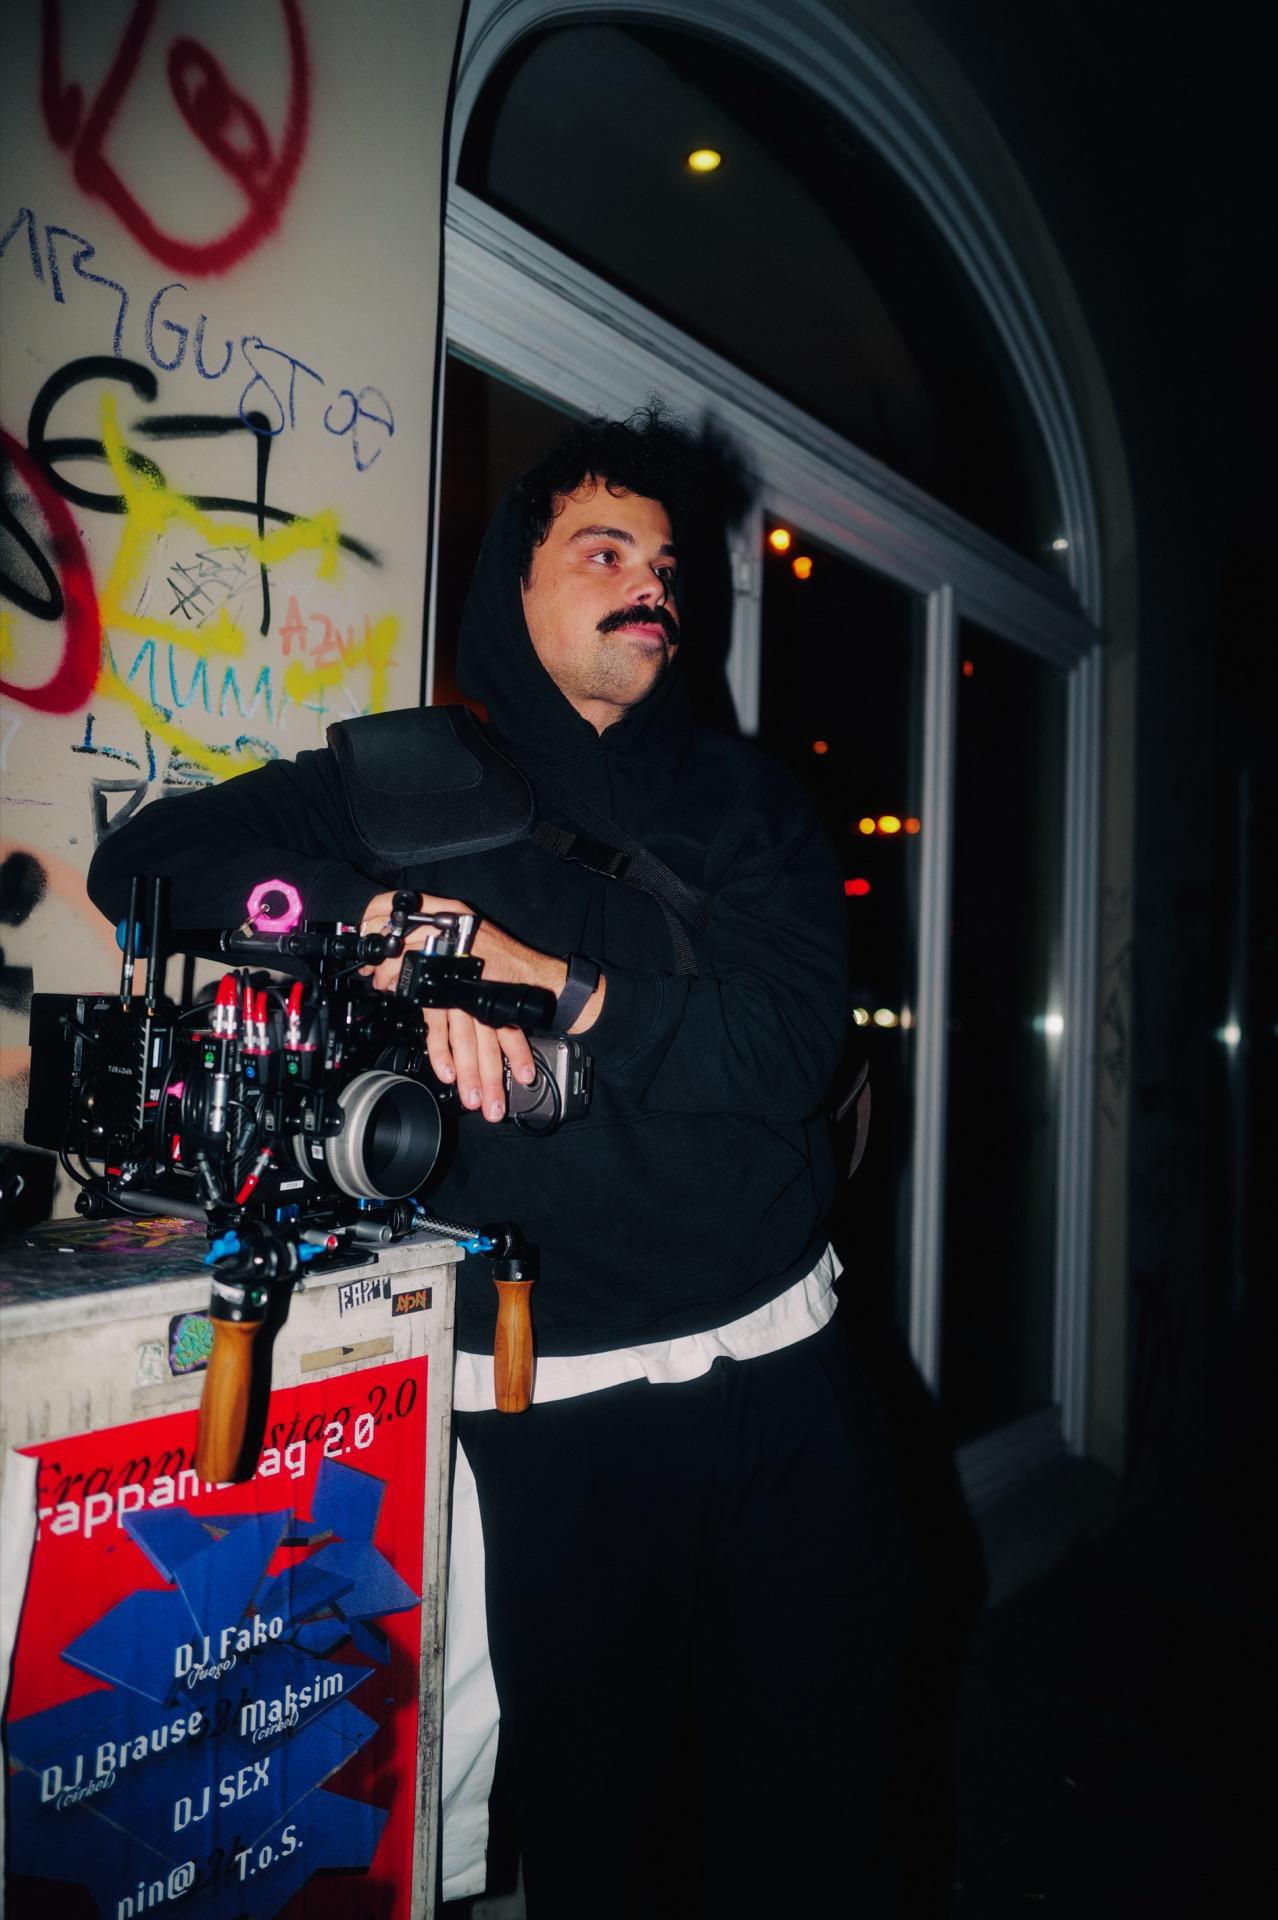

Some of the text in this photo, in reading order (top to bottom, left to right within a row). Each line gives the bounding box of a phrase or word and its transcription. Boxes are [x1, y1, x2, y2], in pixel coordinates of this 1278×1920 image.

[367, 1377, 417, 1426] 2.0
[324, 1412, 374, 1458] 2.0
[174, 1614, 283, 1678] DJ Fako
[41, 1754, 84, 1803] DJ
[95, 1711, 203, 1778] Brause
[173, 1756, 271, 1832] DJ SEX
[235, 1824, 304, 1881] T.o.S.
